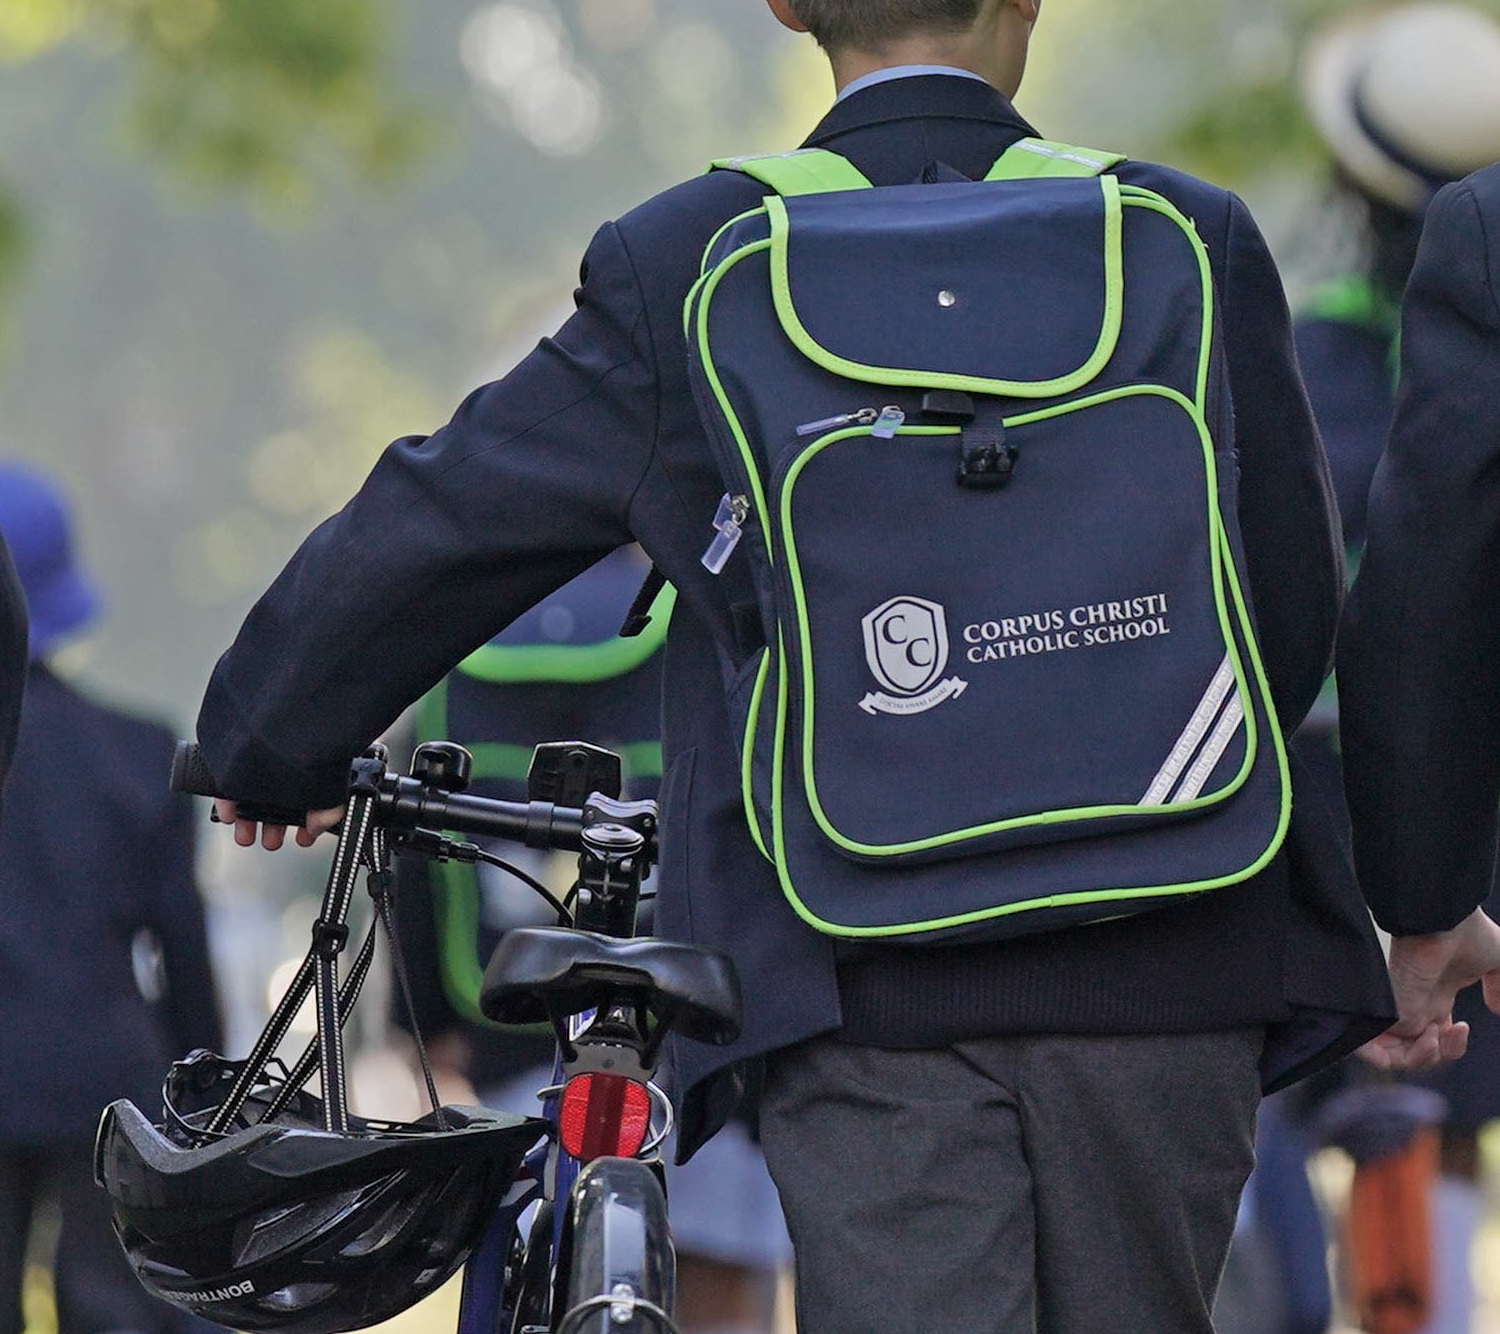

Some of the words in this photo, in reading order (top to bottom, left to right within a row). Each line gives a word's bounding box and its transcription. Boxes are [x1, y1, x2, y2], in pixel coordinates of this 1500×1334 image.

[963, 610, 1064, 643] CORPUS
[1069, 593, 1168, 627] CHRISTI
[966, 629, 1080, 663] CATHOLIC
[1083, 616, 1170, 646] SCHOOL
